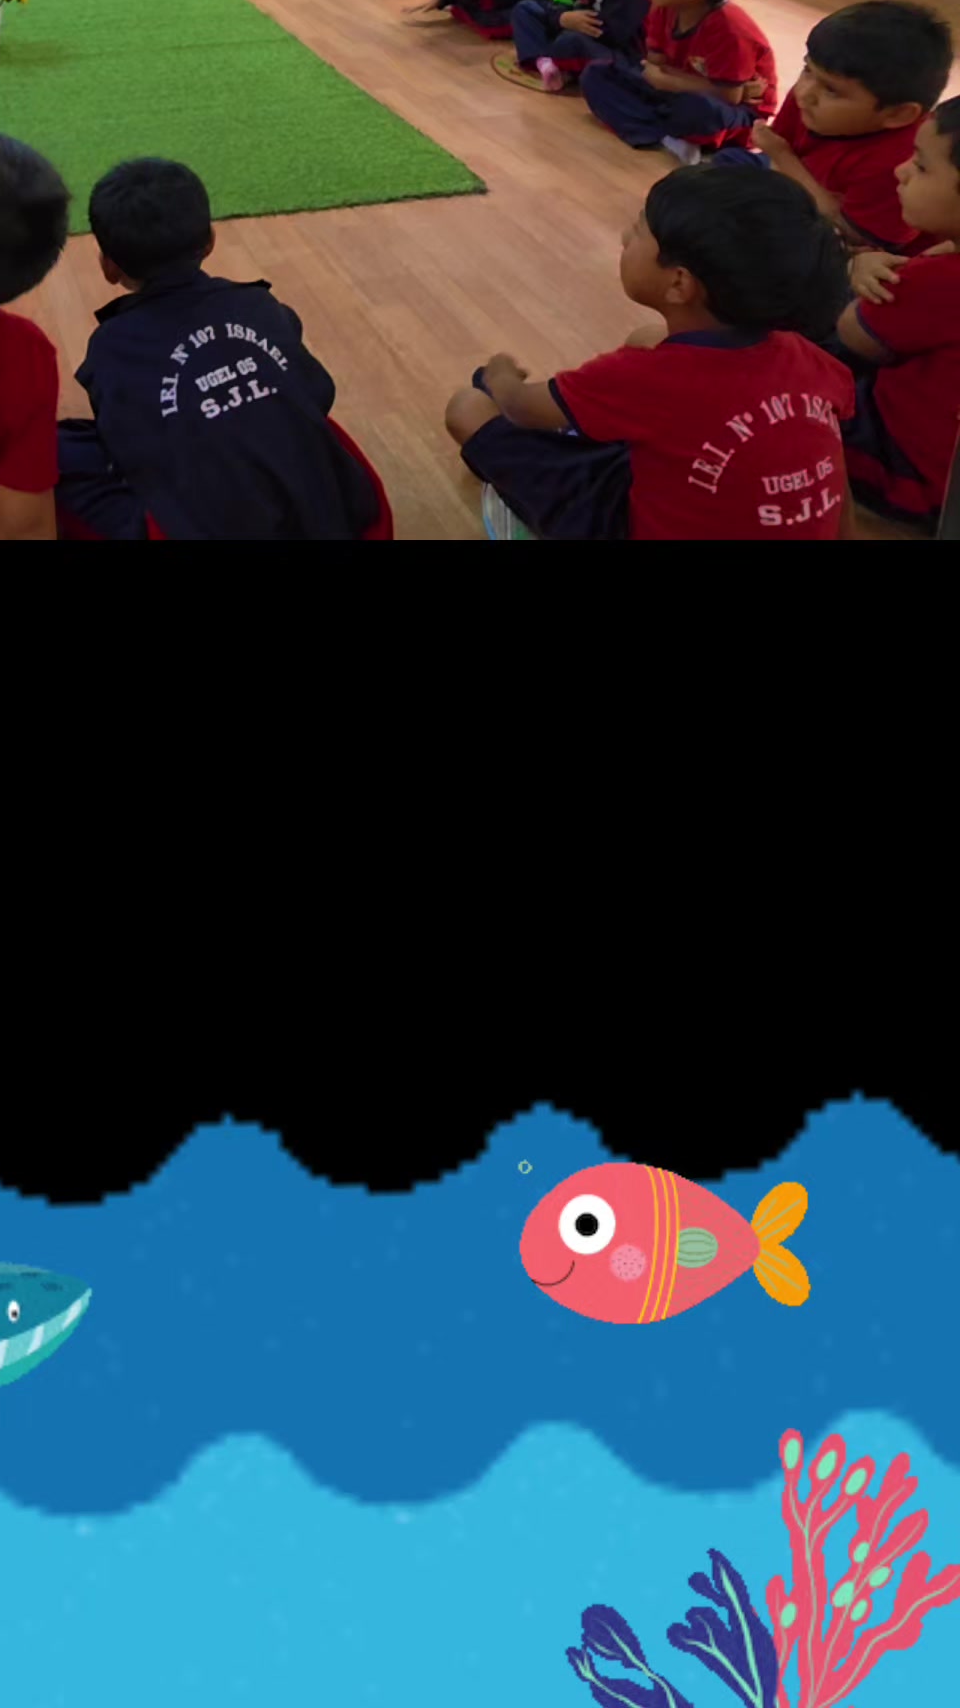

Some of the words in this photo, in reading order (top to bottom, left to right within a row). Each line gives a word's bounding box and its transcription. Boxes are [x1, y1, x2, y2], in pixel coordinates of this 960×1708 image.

[189, 326, 216, 349] 107
[225, 322, 289, 372] ISRAEL
[195, 365, 237, 393] UGEL
[236, 357, 258, 376] 05
[200, 379, 279, 419] S.J.L.
[759, 393, 795, 425] 107
[761, 468, 815, 495] UGEL
[815, 455, 834, 481] 05
[757, 487, 841, 527] S.J.L.
